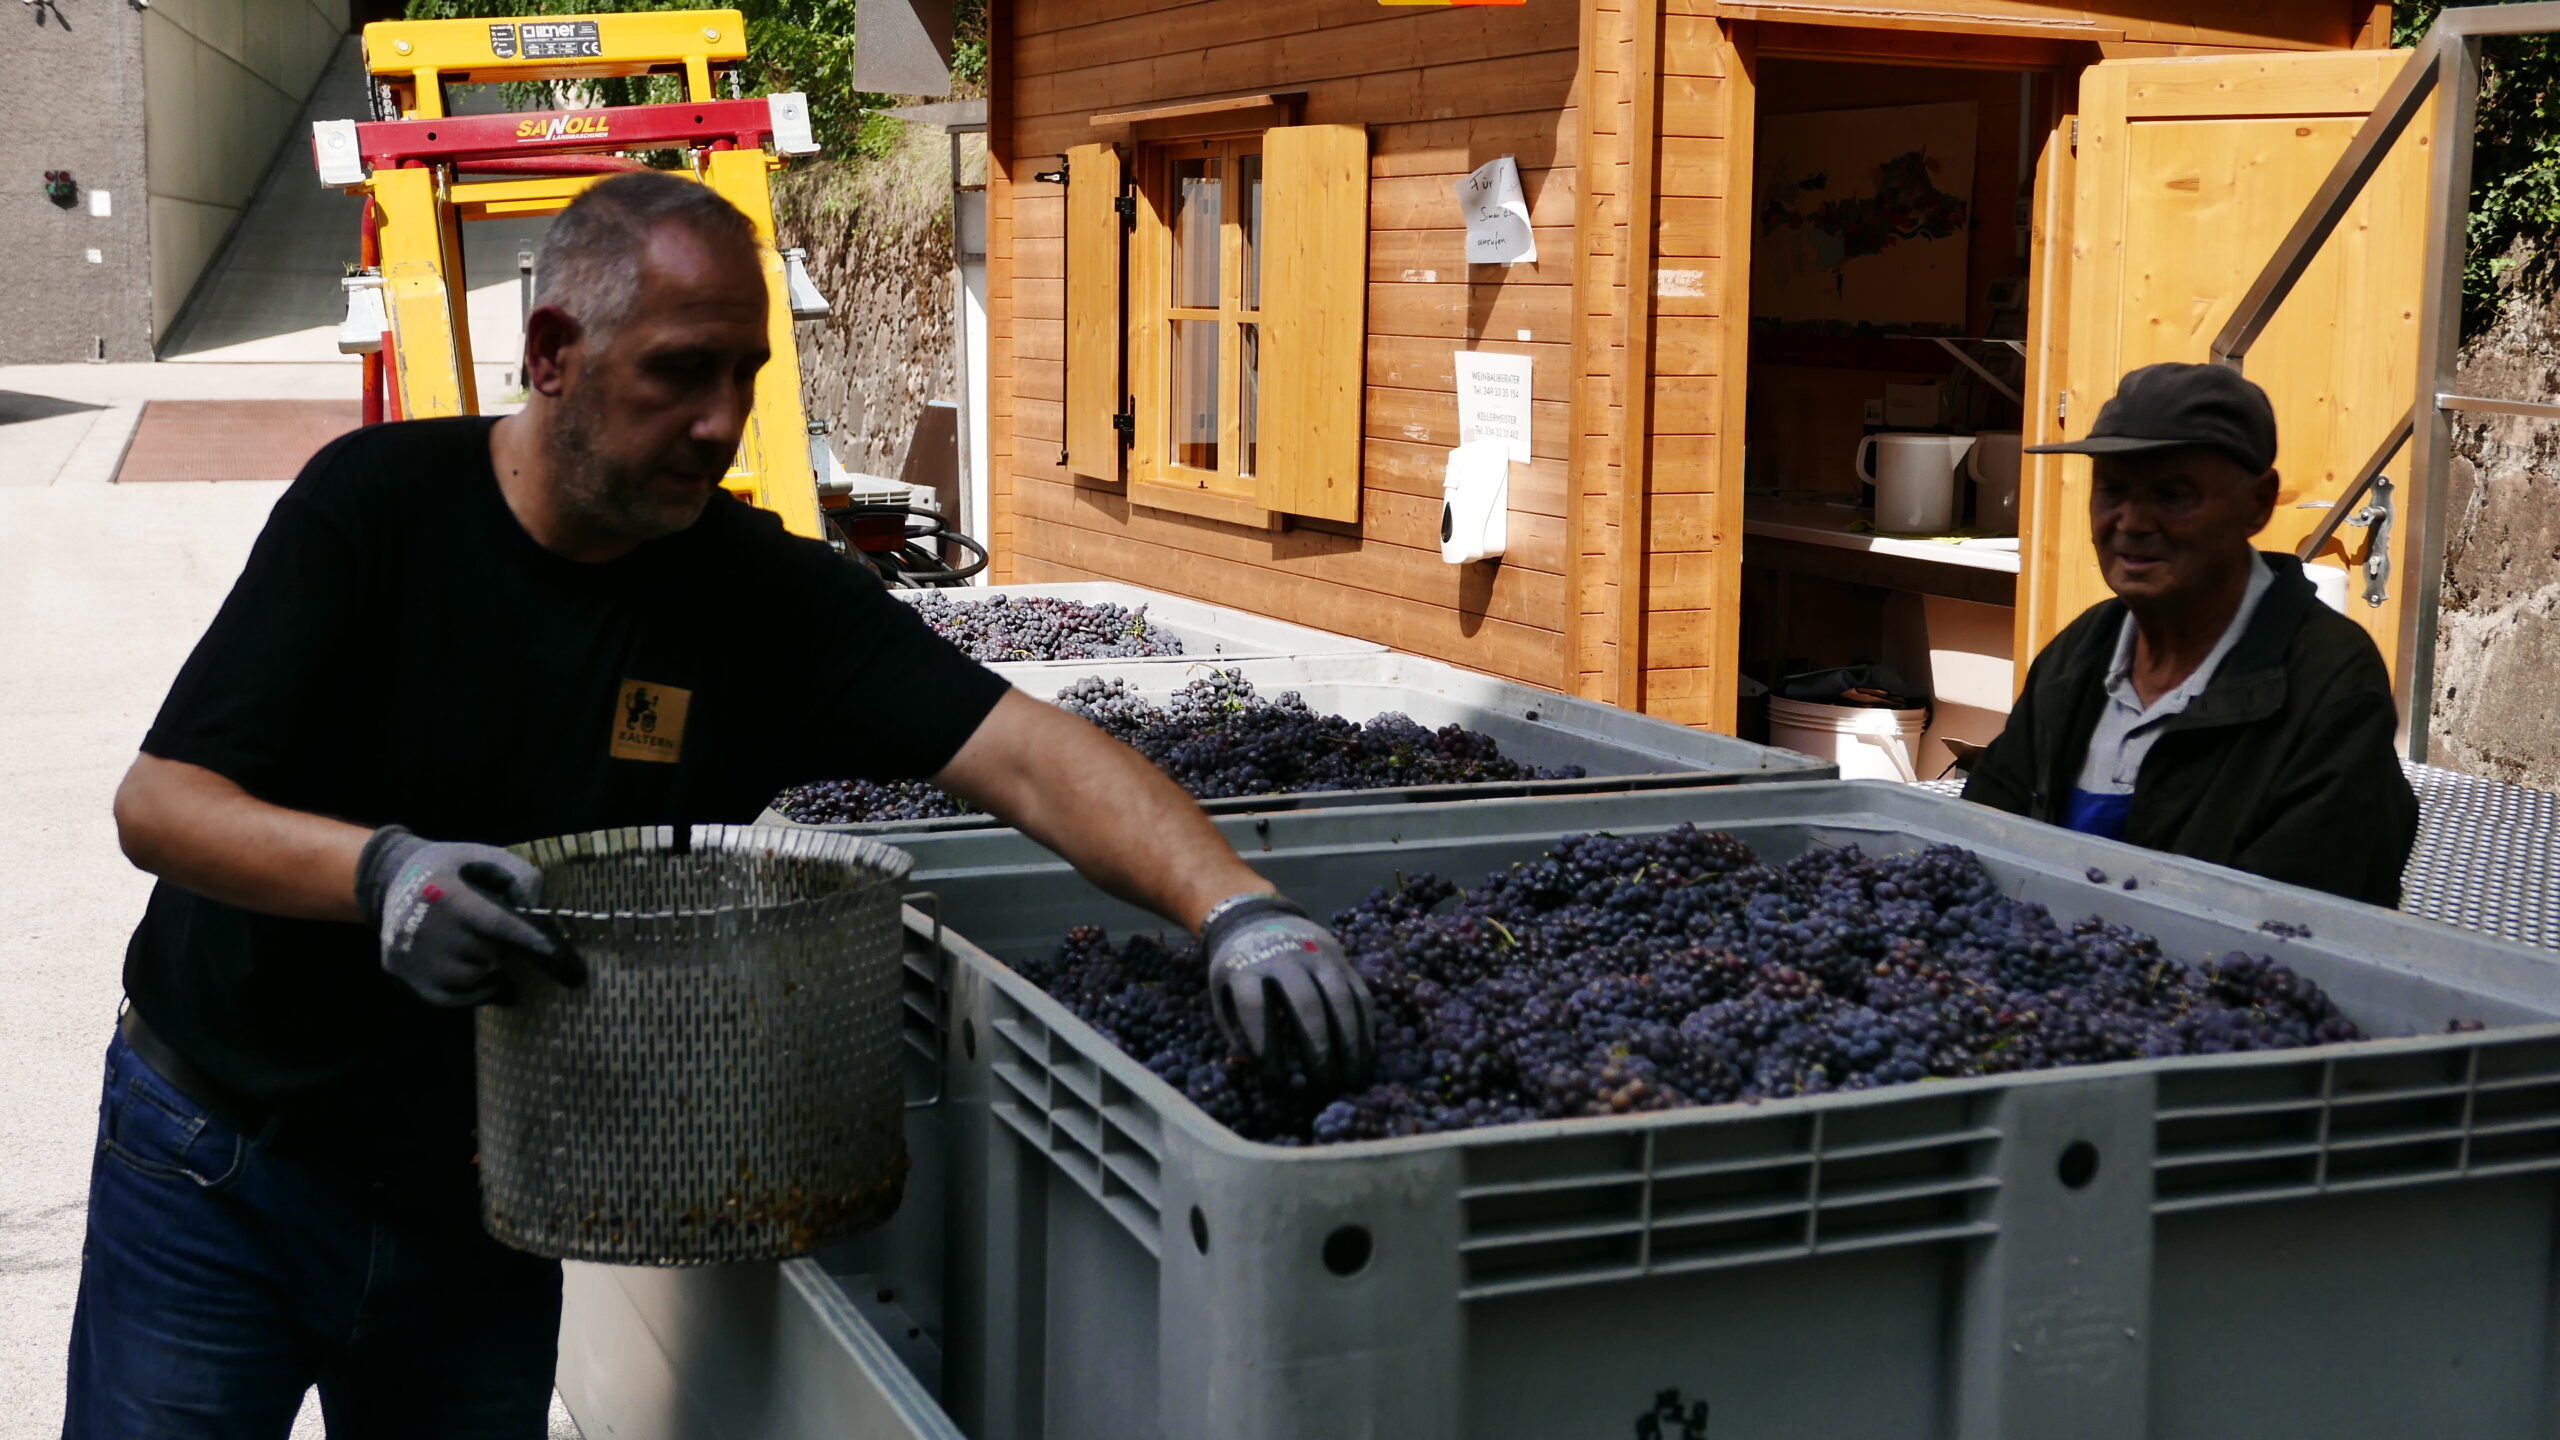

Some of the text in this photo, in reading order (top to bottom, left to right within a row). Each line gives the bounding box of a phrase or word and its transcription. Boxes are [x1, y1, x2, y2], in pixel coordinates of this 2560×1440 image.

[516, 115, 609, 140] SANOLL
[1469, 171, 1493, 191] Für
[1472, 371, 1520, 384] WEINBAUBERATER
[1477, 412, 1517, 425] KELLERMEISTER
[619, 731, 674, 749] KALTERN
